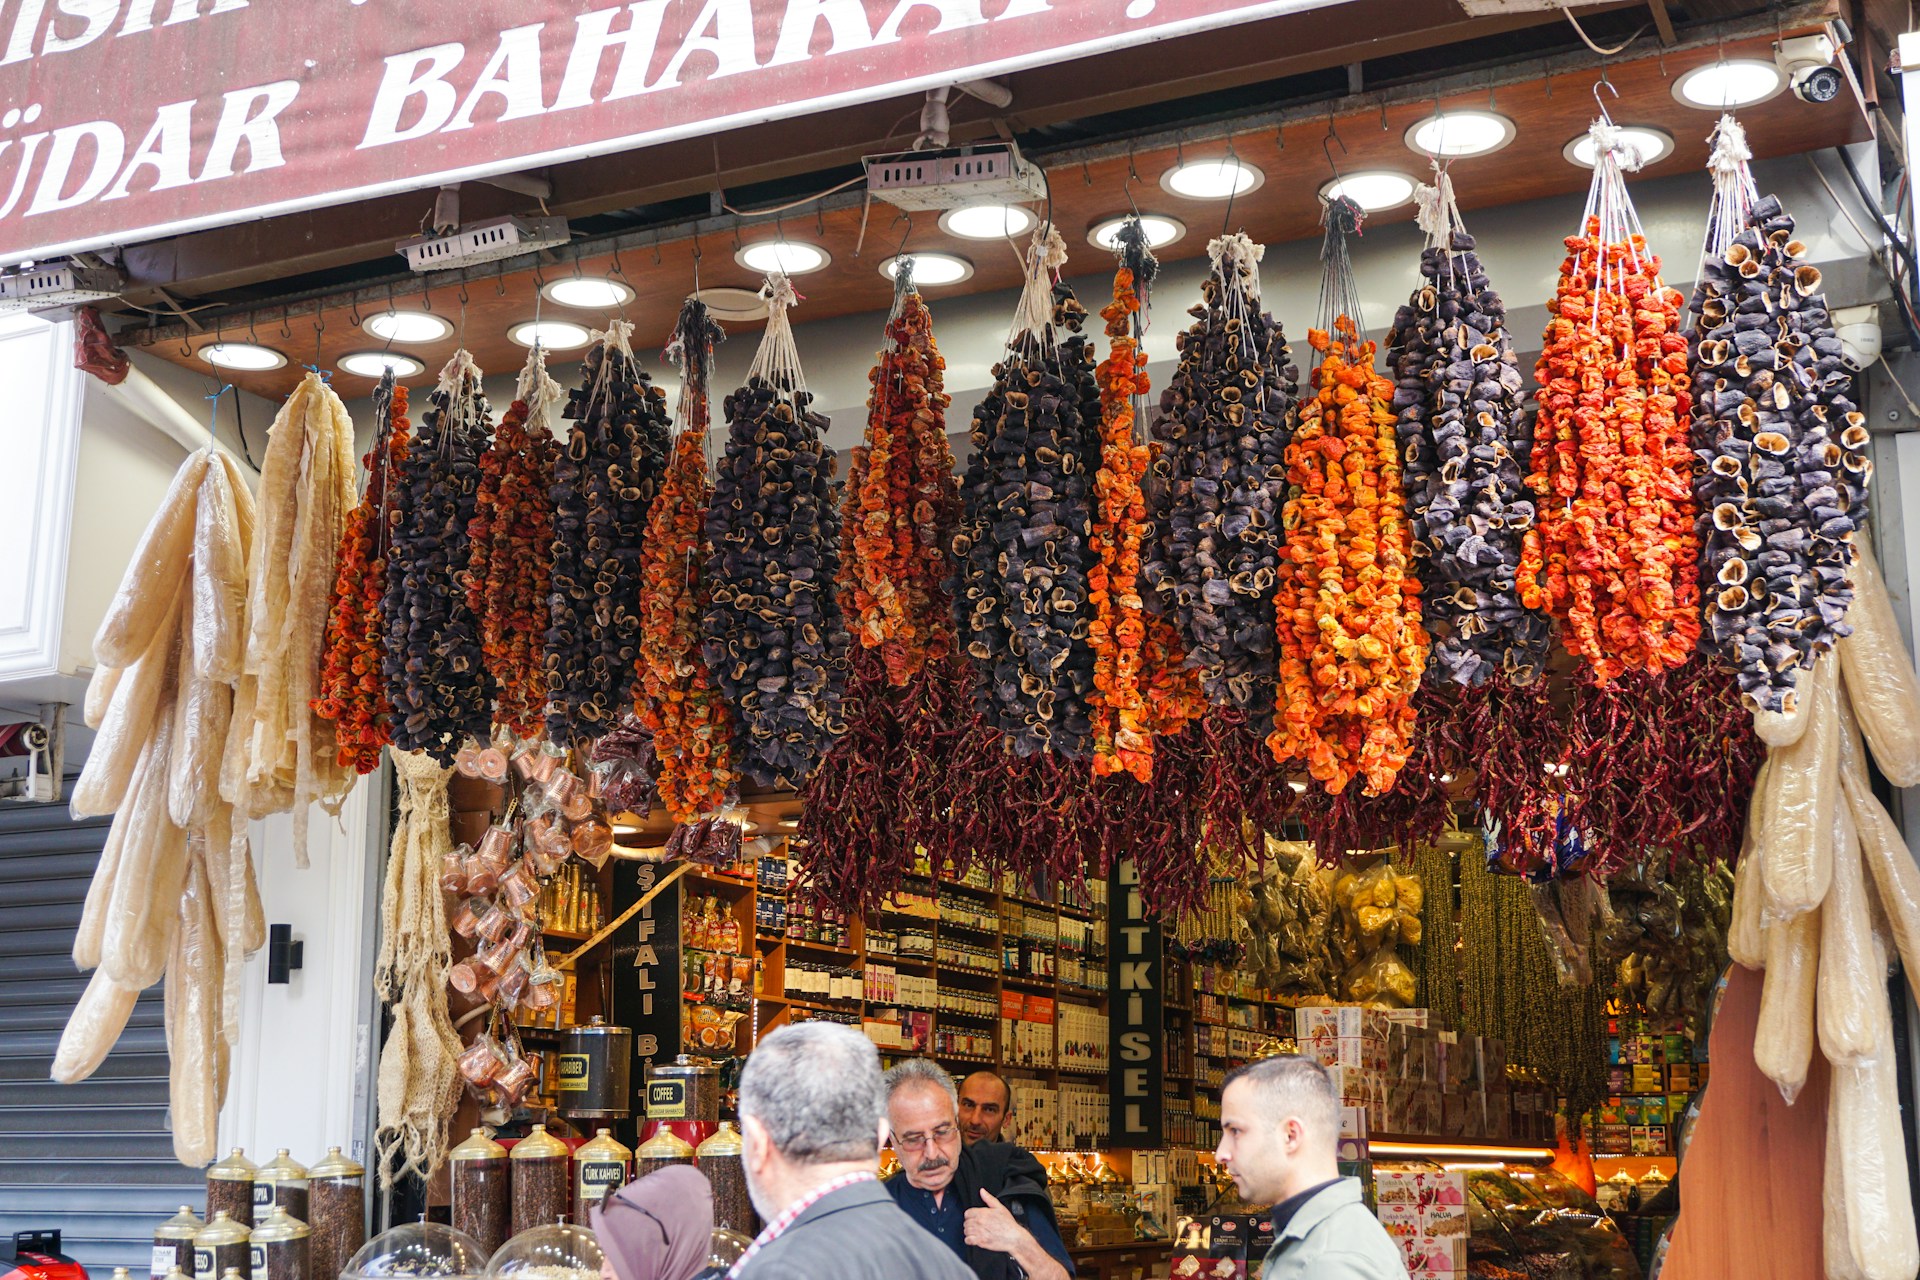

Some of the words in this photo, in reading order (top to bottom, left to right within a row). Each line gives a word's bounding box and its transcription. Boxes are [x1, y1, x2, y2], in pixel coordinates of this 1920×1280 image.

[653, 1087, 673, 1101] COFFEE
[585, 1166, 598, 1180] TÜRK
[600, 1166, 620, 1180] KAHVESİ
